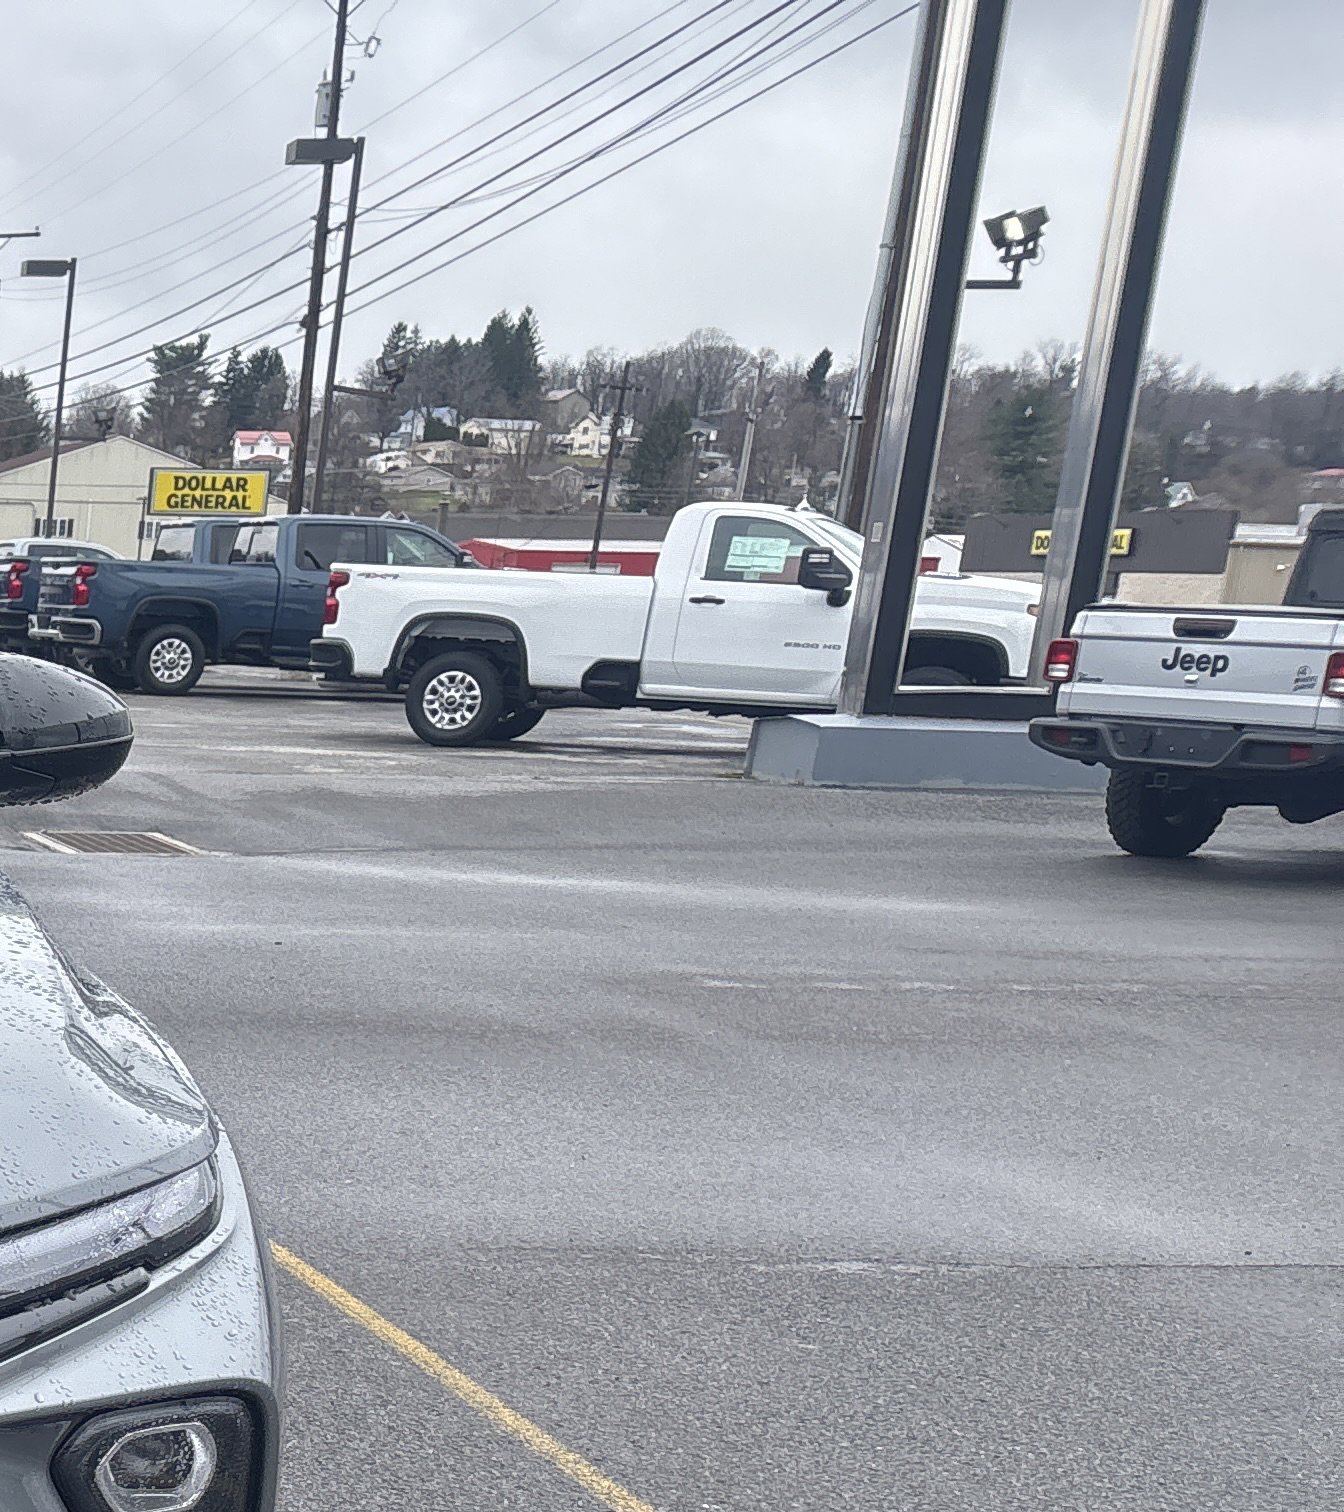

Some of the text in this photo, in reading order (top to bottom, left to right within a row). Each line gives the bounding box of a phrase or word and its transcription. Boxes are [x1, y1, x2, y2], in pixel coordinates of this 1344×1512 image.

[173, 475, 249, 493] DOLLAR
[166, 493, 252, 510] GENERAL
[1161, 646, 1230, 678] Jeep
